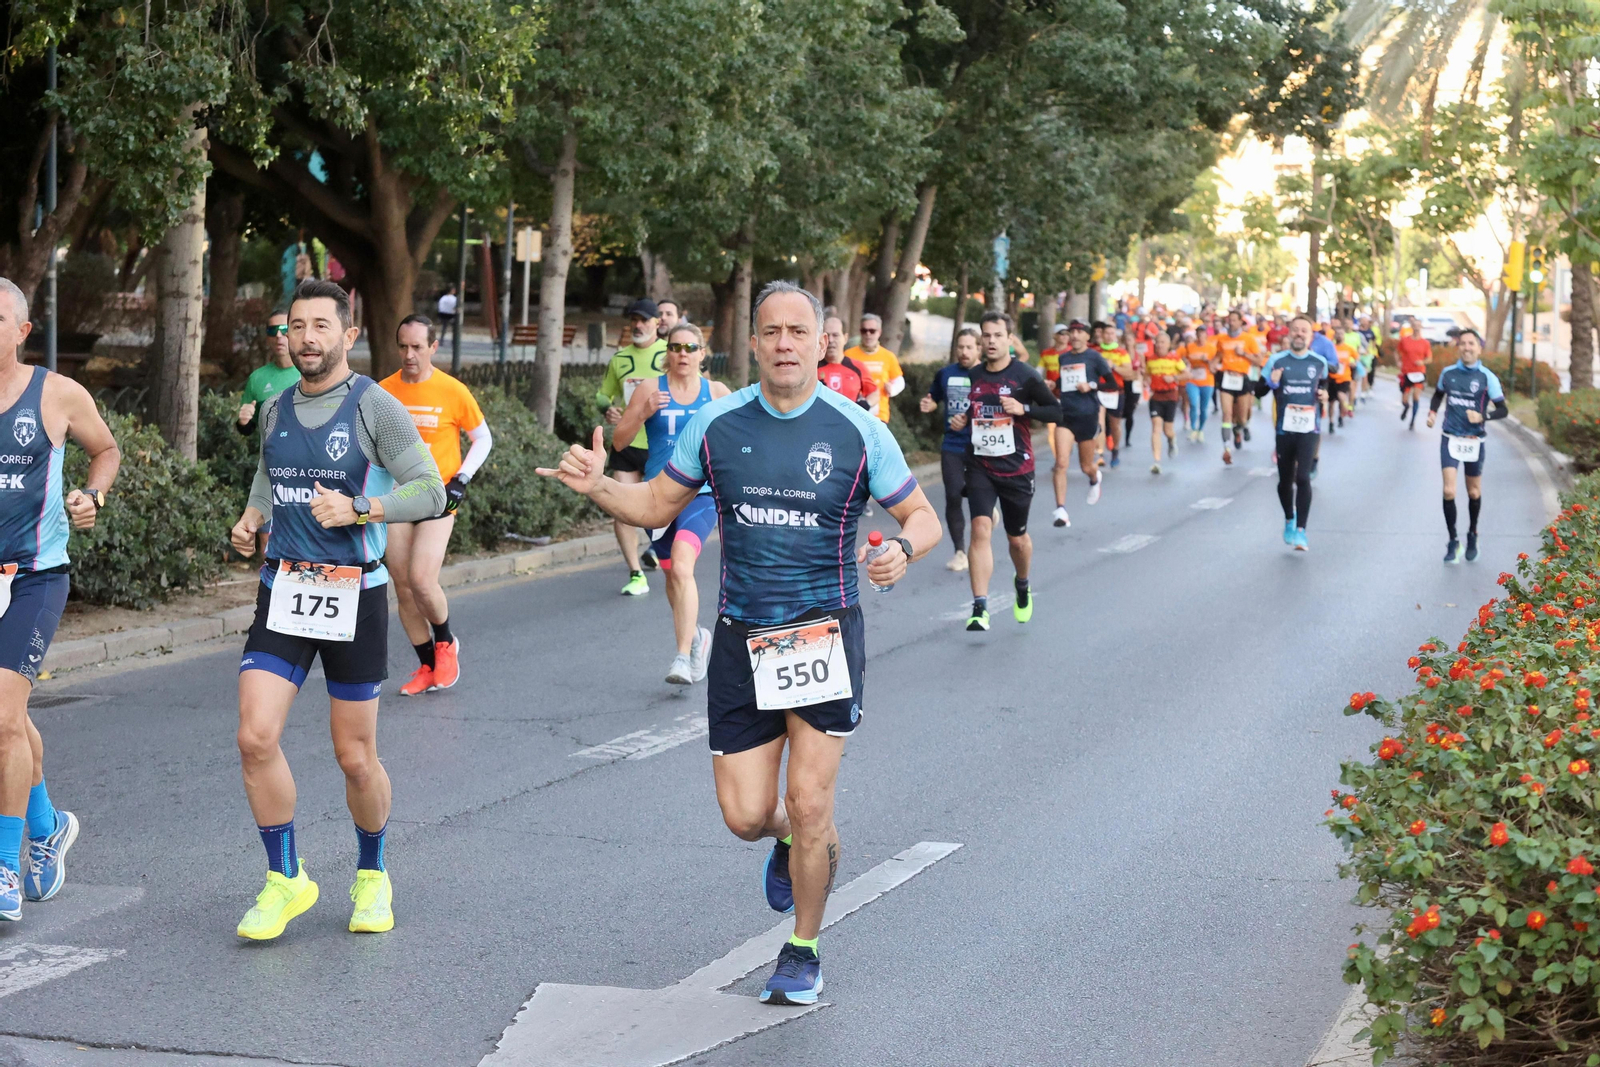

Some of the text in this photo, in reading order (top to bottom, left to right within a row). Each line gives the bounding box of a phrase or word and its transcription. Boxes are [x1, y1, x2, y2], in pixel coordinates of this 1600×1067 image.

[981, 434, 1006, 447] 594
[0, 454, 34, 464] ORRER
[269, 467, 346, 480] TOD@S A CORRER
[742, 486, 772, 496] TOD@S
[783, 489, 816, 500] CORRER
[291, 592, 339, 619] 175
[776, 658, 829, 691] 550
